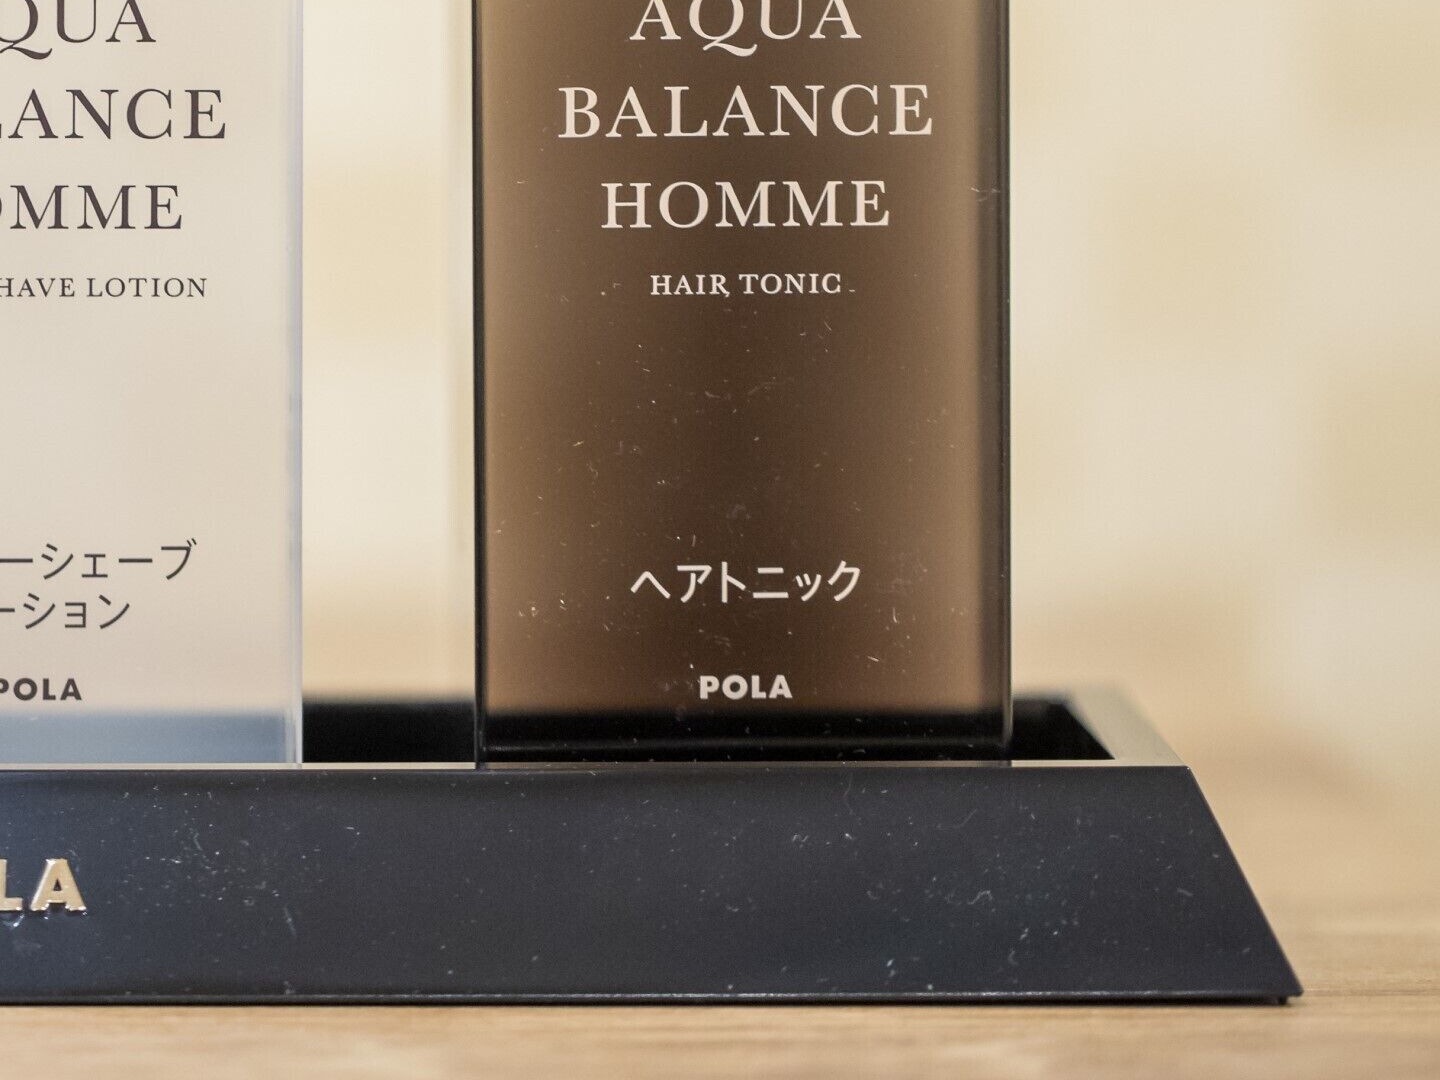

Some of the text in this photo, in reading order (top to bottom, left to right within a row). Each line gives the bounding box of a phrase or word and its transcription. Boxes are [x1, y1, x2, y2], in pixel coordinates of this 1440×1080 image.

[558, 84, 932, 138] BALANCE
[601, 181, 889, 228] HOMME
[87, 278, 206, 297] LOTION
[651, 273, 840, 297] HAIR TONIC
[631, 561, 860, 603] ヘアトニック
[698, 675, 792, 699] POLA
